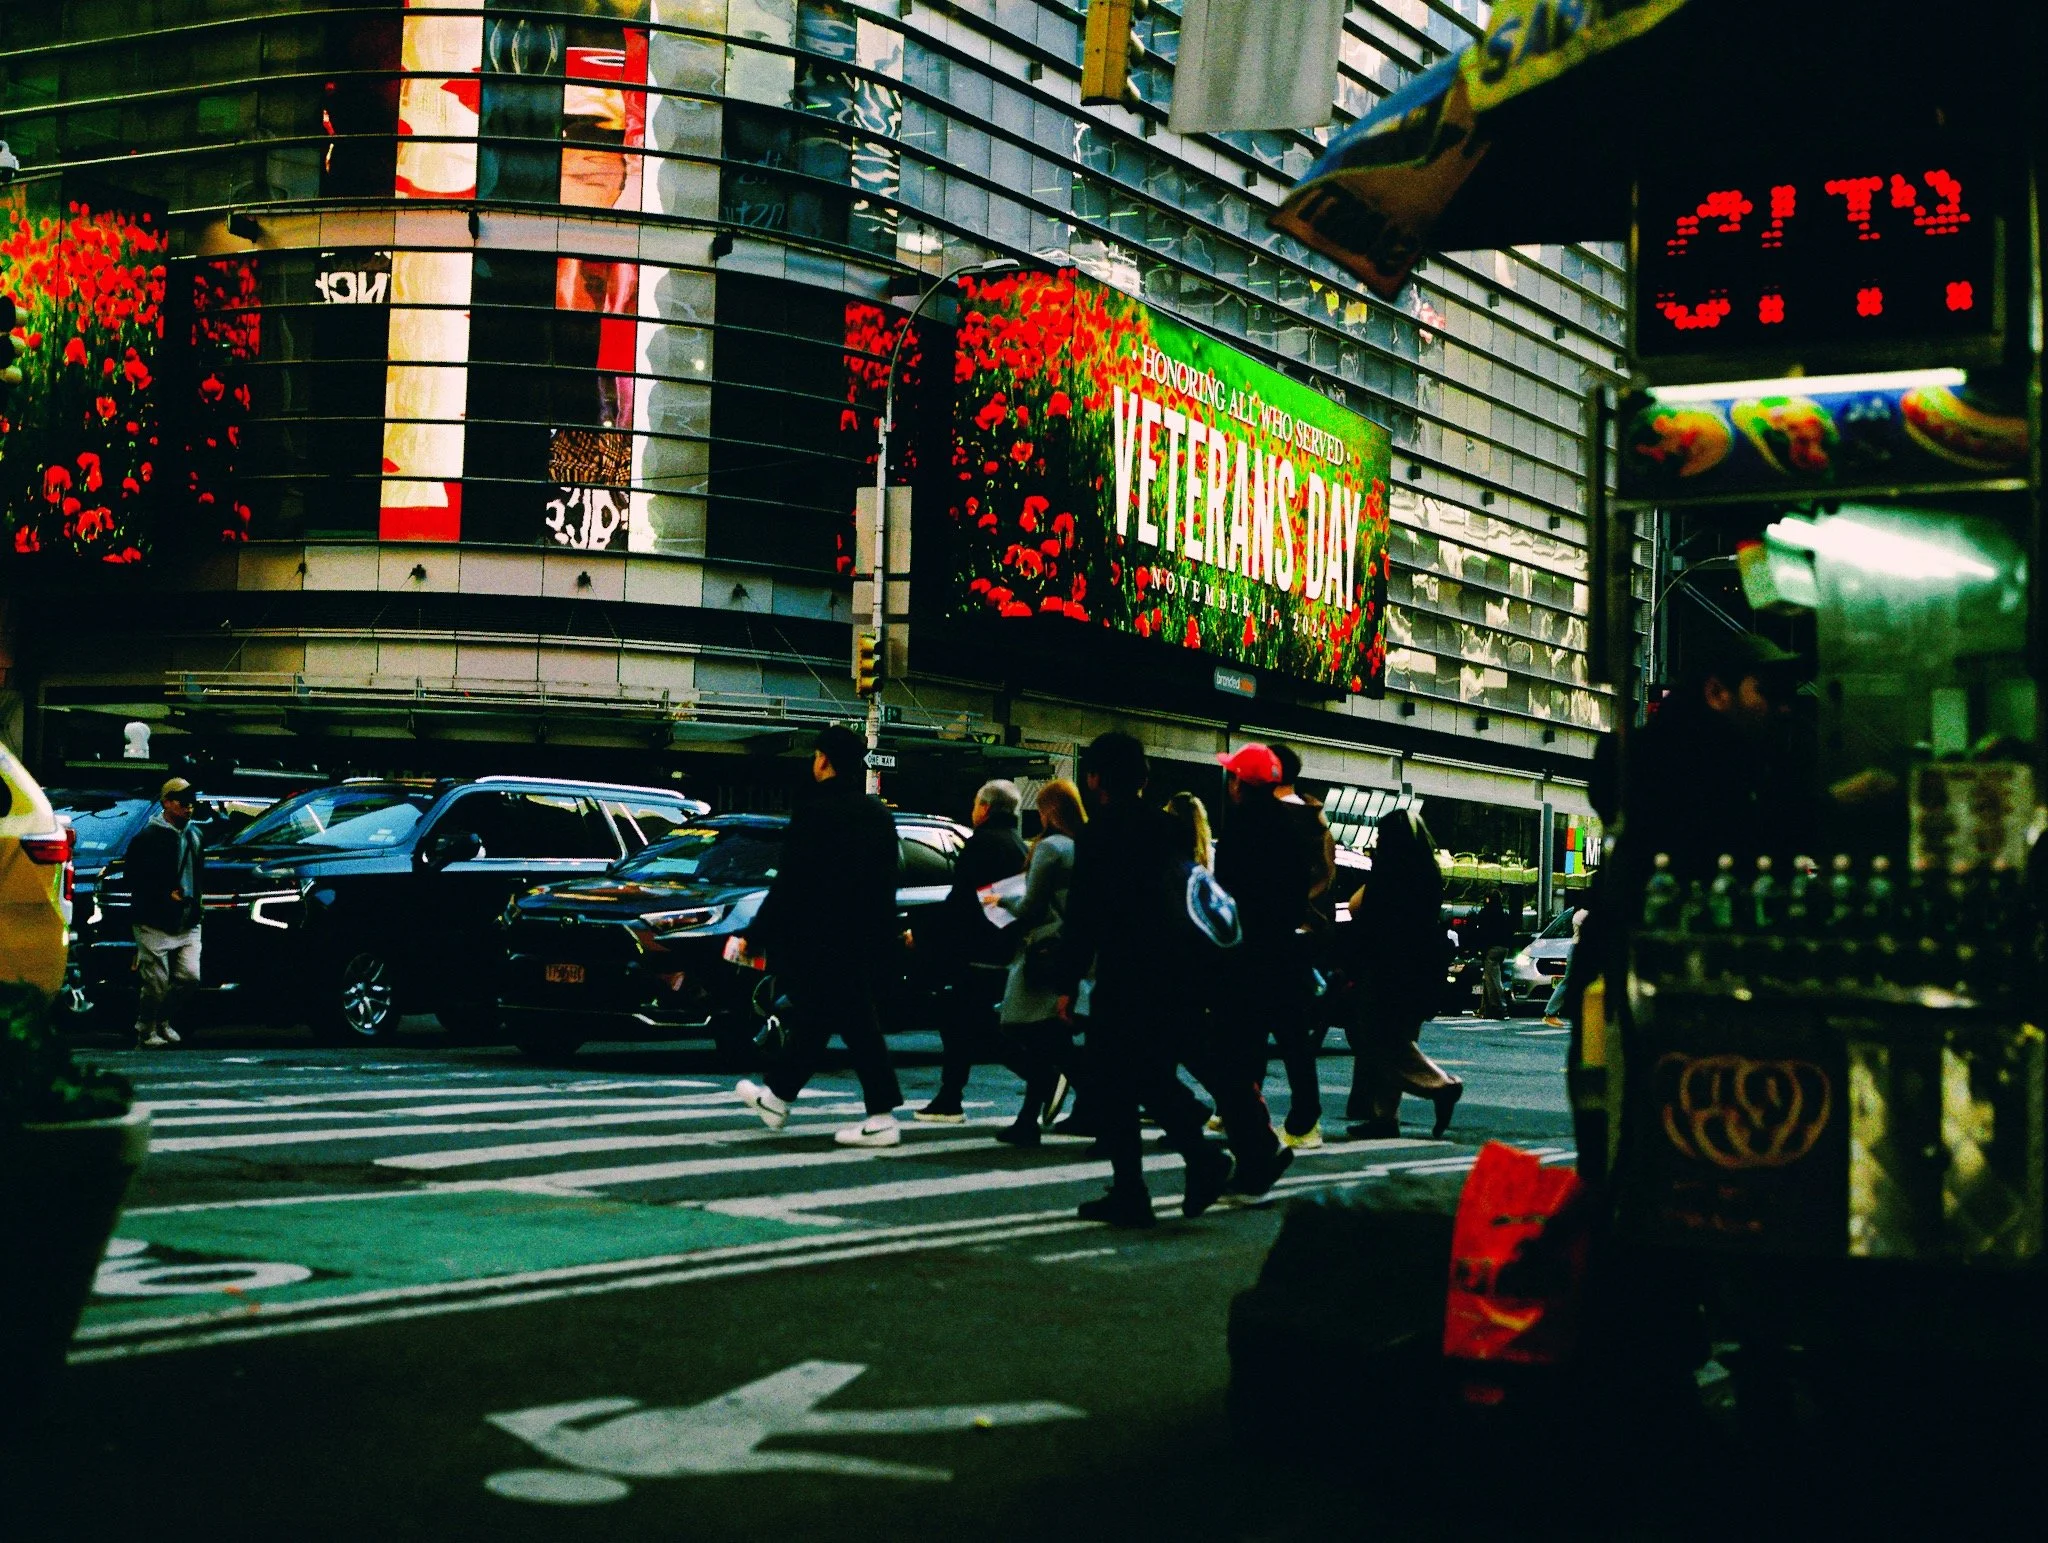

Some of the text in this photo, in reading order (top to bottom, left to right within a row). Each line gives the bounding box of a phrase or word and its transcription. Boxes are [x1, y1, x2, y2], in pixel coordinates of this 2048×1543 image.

[1141, 344, 1344, 466] HONORING ALL WHO SERVED
[1113, 385, 1362, 612] VETERANS DAY
[1151, 567, 1249, 617] NOVEMBER
[1292, 612, 1327, 641] 2024
